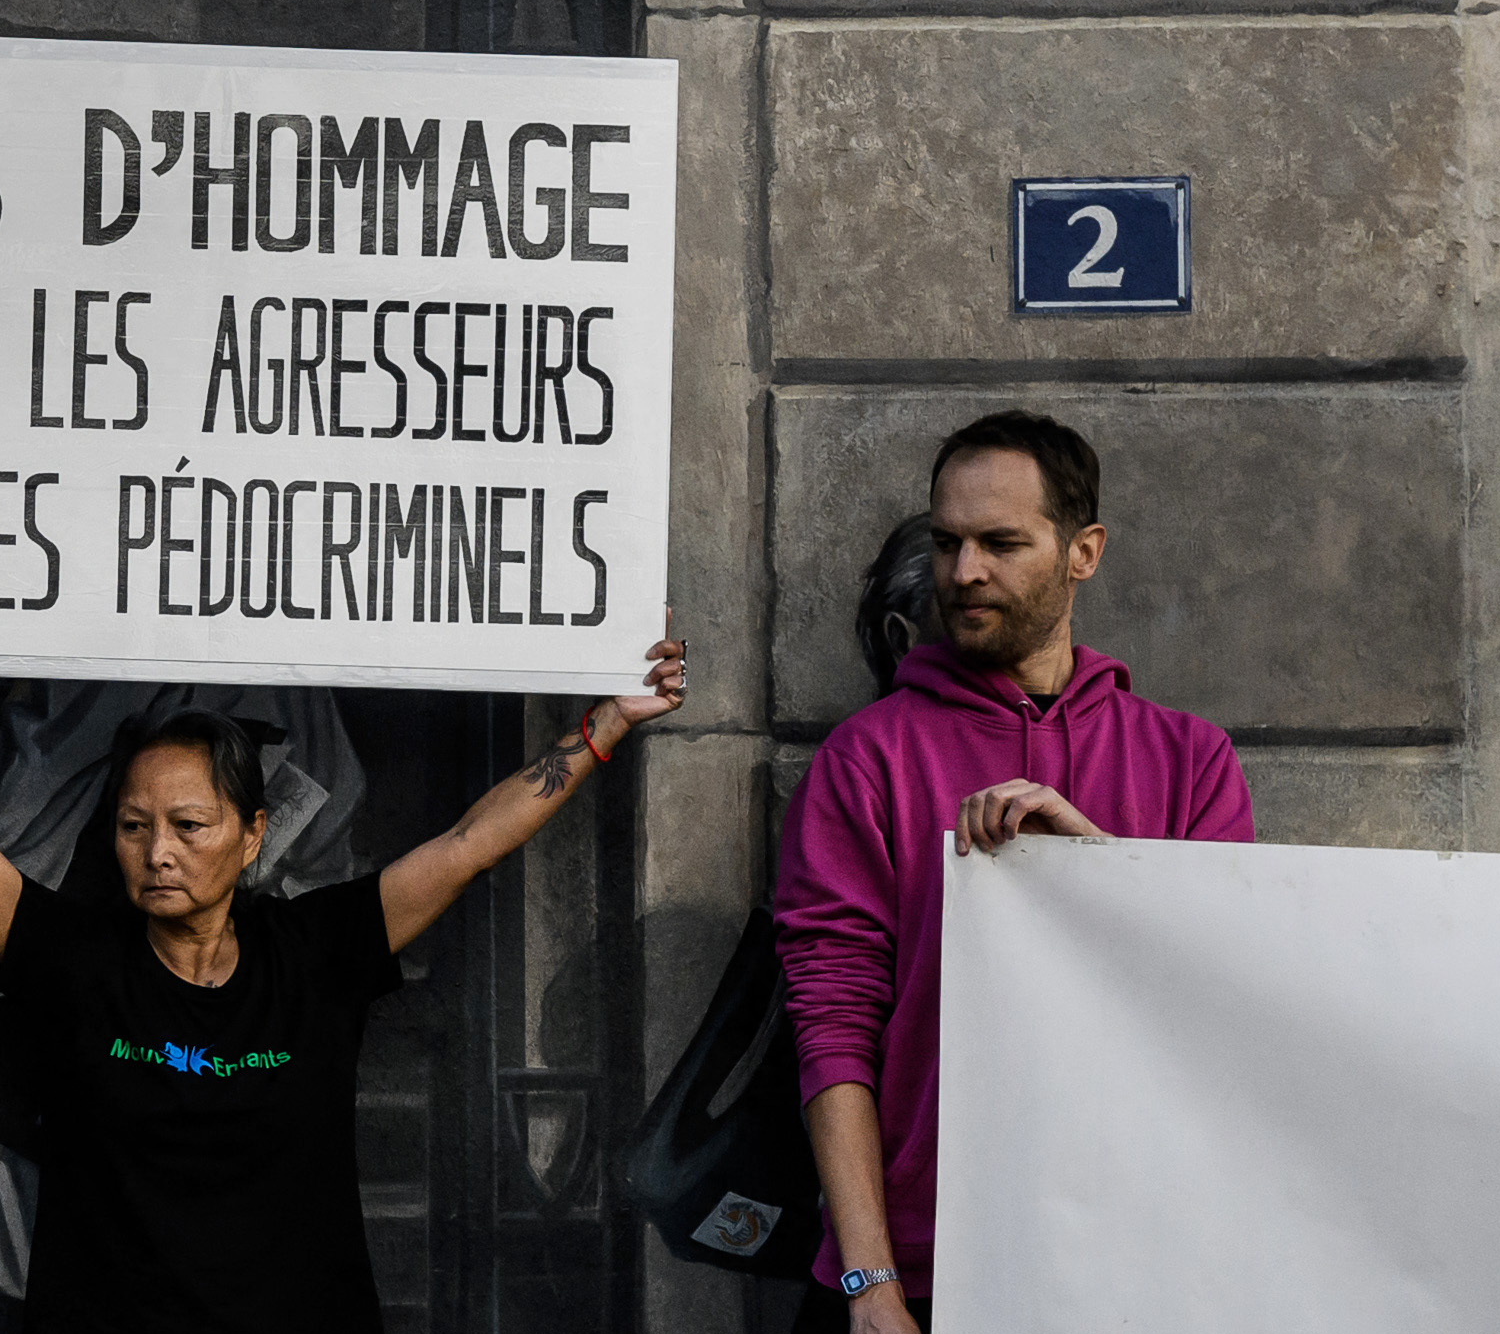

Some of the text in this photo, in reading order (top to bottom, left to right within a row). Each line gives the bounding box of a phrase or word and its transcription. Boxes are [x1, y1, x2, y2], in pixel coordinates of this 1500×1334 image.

[83, 109, 629, 262] D'HOMMAGE
[1067, 204, 1125, 288] 2
[31, 289, 151, 430] LES
[202, 296, 613, 445] AGRESSEURS
[117, 457, 608, 626] PÉDOCRIMINELS
[109, 1038, 164, 1065] Mouv
